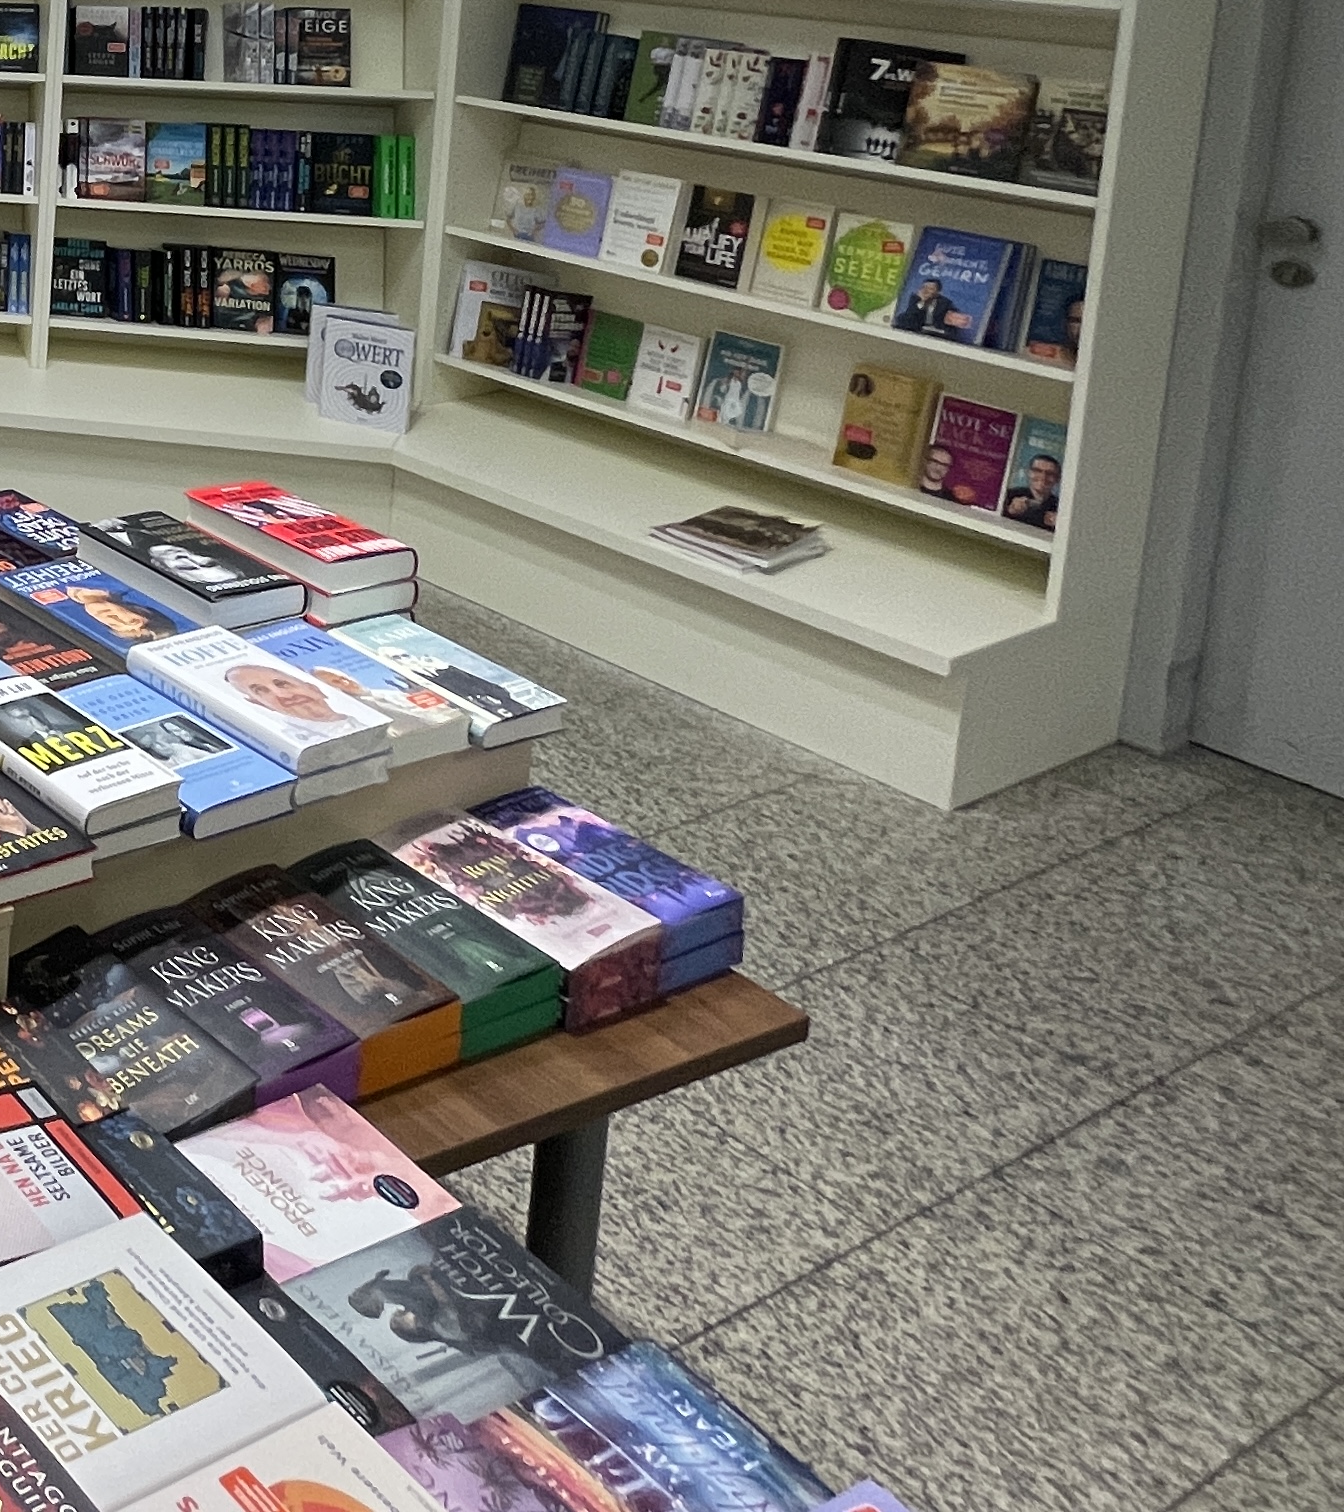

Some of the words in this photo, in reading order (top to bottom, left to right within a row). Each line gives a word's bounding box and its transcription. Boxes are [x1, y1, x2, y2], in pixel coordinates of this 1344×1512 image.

[214, 257, 275, 273] YARROS
[835, 257, 897, 286] SEELE
[918, 262, 989, 283] GEHIRN
[214, 297, 271, 312] VARIATION
[335, 338, 404, 367] QWERT
[8, 681, 33, 694] LAU
[18, 725, 125, 772] MERZ
[16, 825, 68, 849] RITES
[350, 874, 415, 918] KING
[364, 890, 465, 937] MAKERS
[251, 900, 318, 944] KING
[265, 916, 365, 972] MAKERS
[150, 945, 218, 988] KING
[167, 958, 265, 1013] MAKERS
[79, 1006, 160, 1062] DREAMS
[109, 1033, 201, 1113] BENEATH
[6, 1136, 72, 1203] SELTSAME
[29, 1131, 76, 1184] BILDER
[13, 1168, 50, 1208] HEN
[442, 1242, 544, 1348] WITCH
[450, 1219, 604, 1362] COLLECTOR
[23, 1418, 83, 1464] DER
